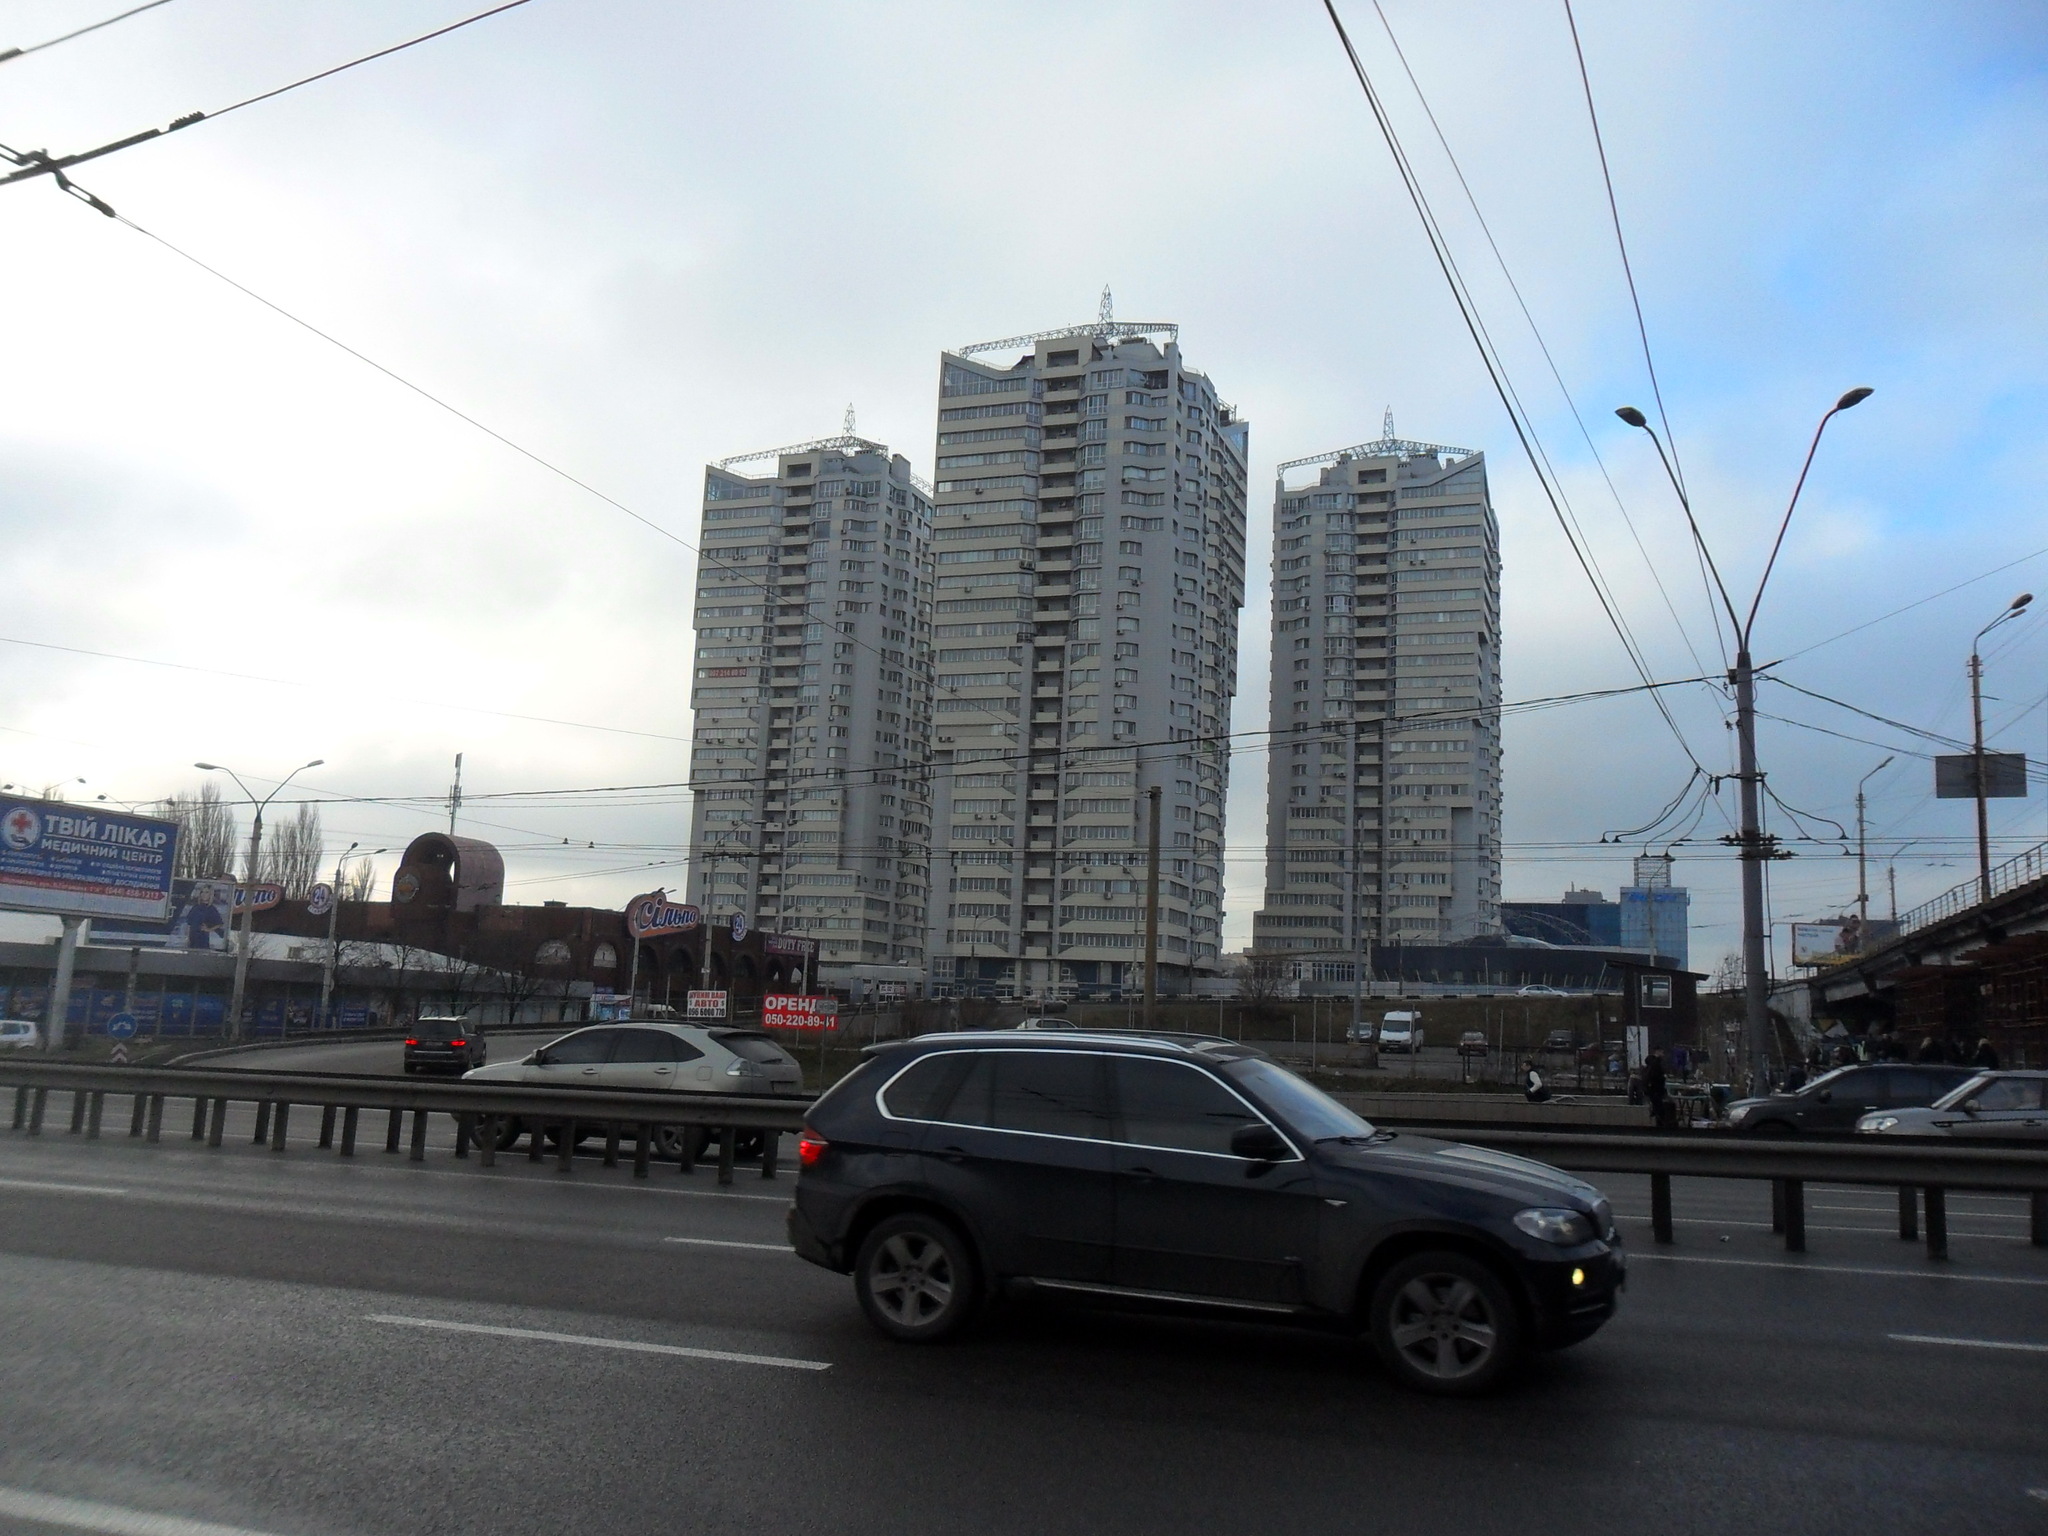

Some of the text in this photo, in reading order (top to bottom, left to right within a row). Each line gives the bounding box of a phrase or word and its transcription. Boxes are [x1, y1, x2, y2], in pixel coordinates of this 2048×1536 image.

[45, 815, 167, 848] ТВІЙ ЛІКАР
[41, 839, 118, 859] МЕДИЧНИЙ
[122, 849, 163, 864] ЦЕНТР
[313, 886, 327, 905] 24
[634, 897, 697, 931] Сільпо
[777, 938, 797, 951] DUTY
[694, 999, 719, 1008] АВТО
